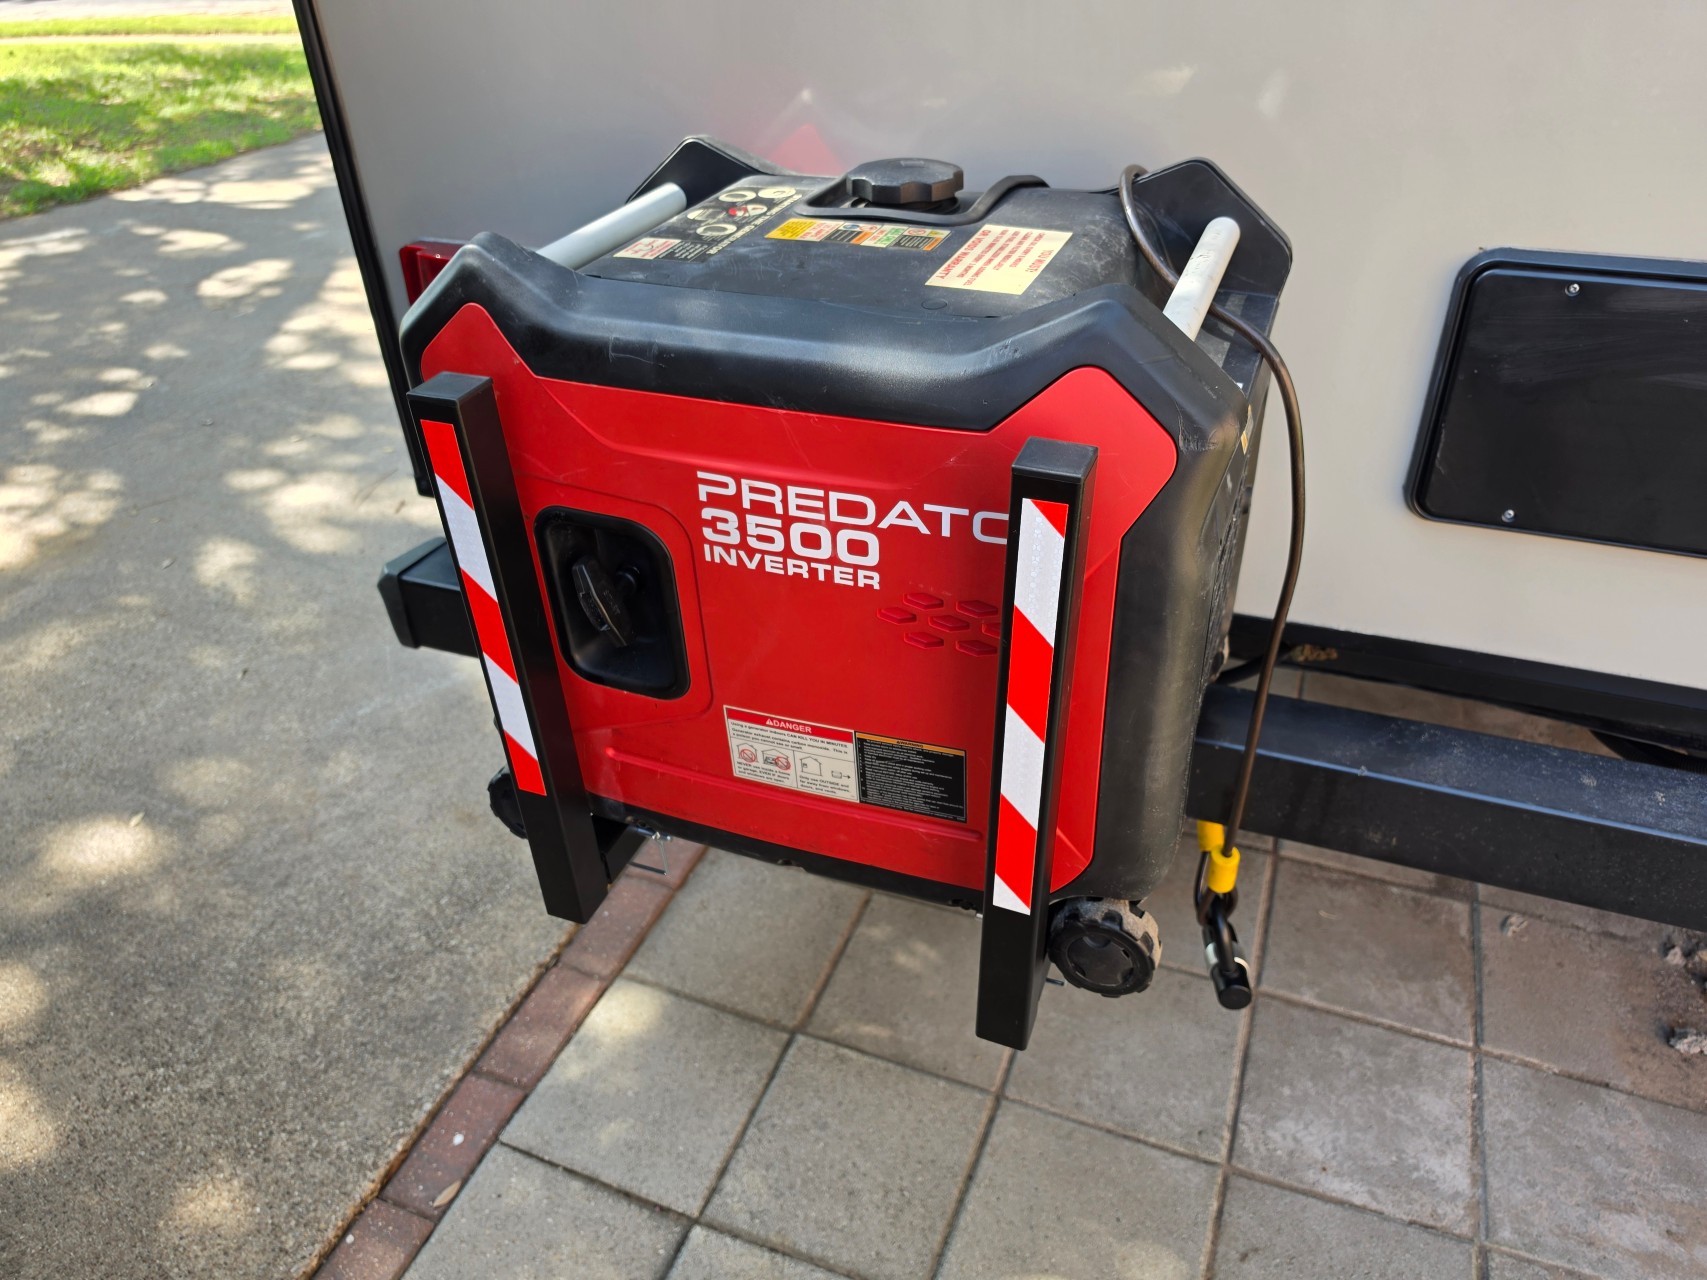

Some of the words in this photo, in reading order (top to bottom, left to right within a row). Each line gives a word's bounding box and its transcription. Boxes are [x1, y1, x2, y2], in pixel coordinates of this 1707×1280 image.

[696, 470, 1010, 545] PREDATO
[700, 507, 880, 567] 3500
[703, 544, 881, 590] INVERTER
[773, 719, 812, 734] DANGER
